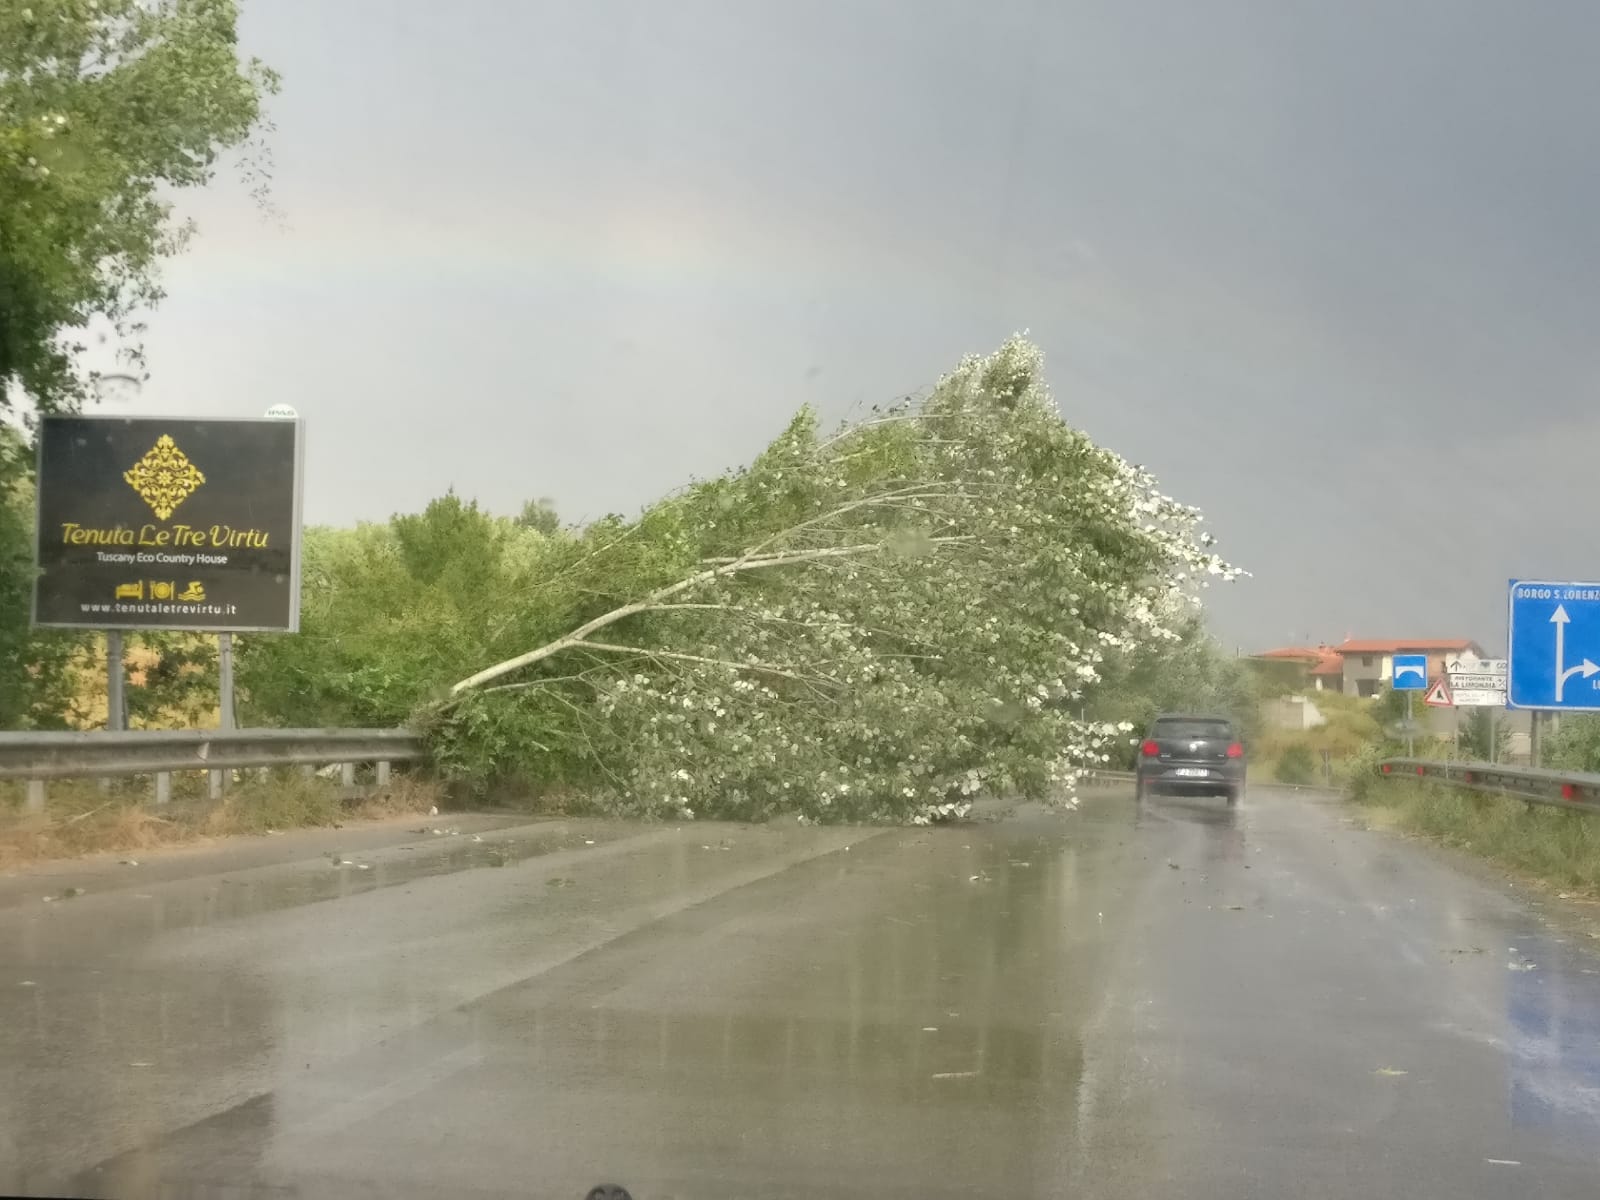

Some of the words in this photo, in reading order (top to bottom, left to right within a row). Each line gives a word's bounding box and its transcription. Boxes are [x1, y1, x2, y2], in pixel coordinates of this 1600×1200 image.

[61, 522, 134, 544] Tenuta
[138, 524, 170, 546] Le
[172, 525, 207, 546] Tre
[96, 552, 136, 564] Tuscany
[137, 553, 155, 563] Eco
[156, 553, 195, 566] Country
[196, 553, 228, 564] House
[1518, 588, 1551, 599] BORGO
[80, 603, 237, 615] www.tenutaletrevirtu.it
